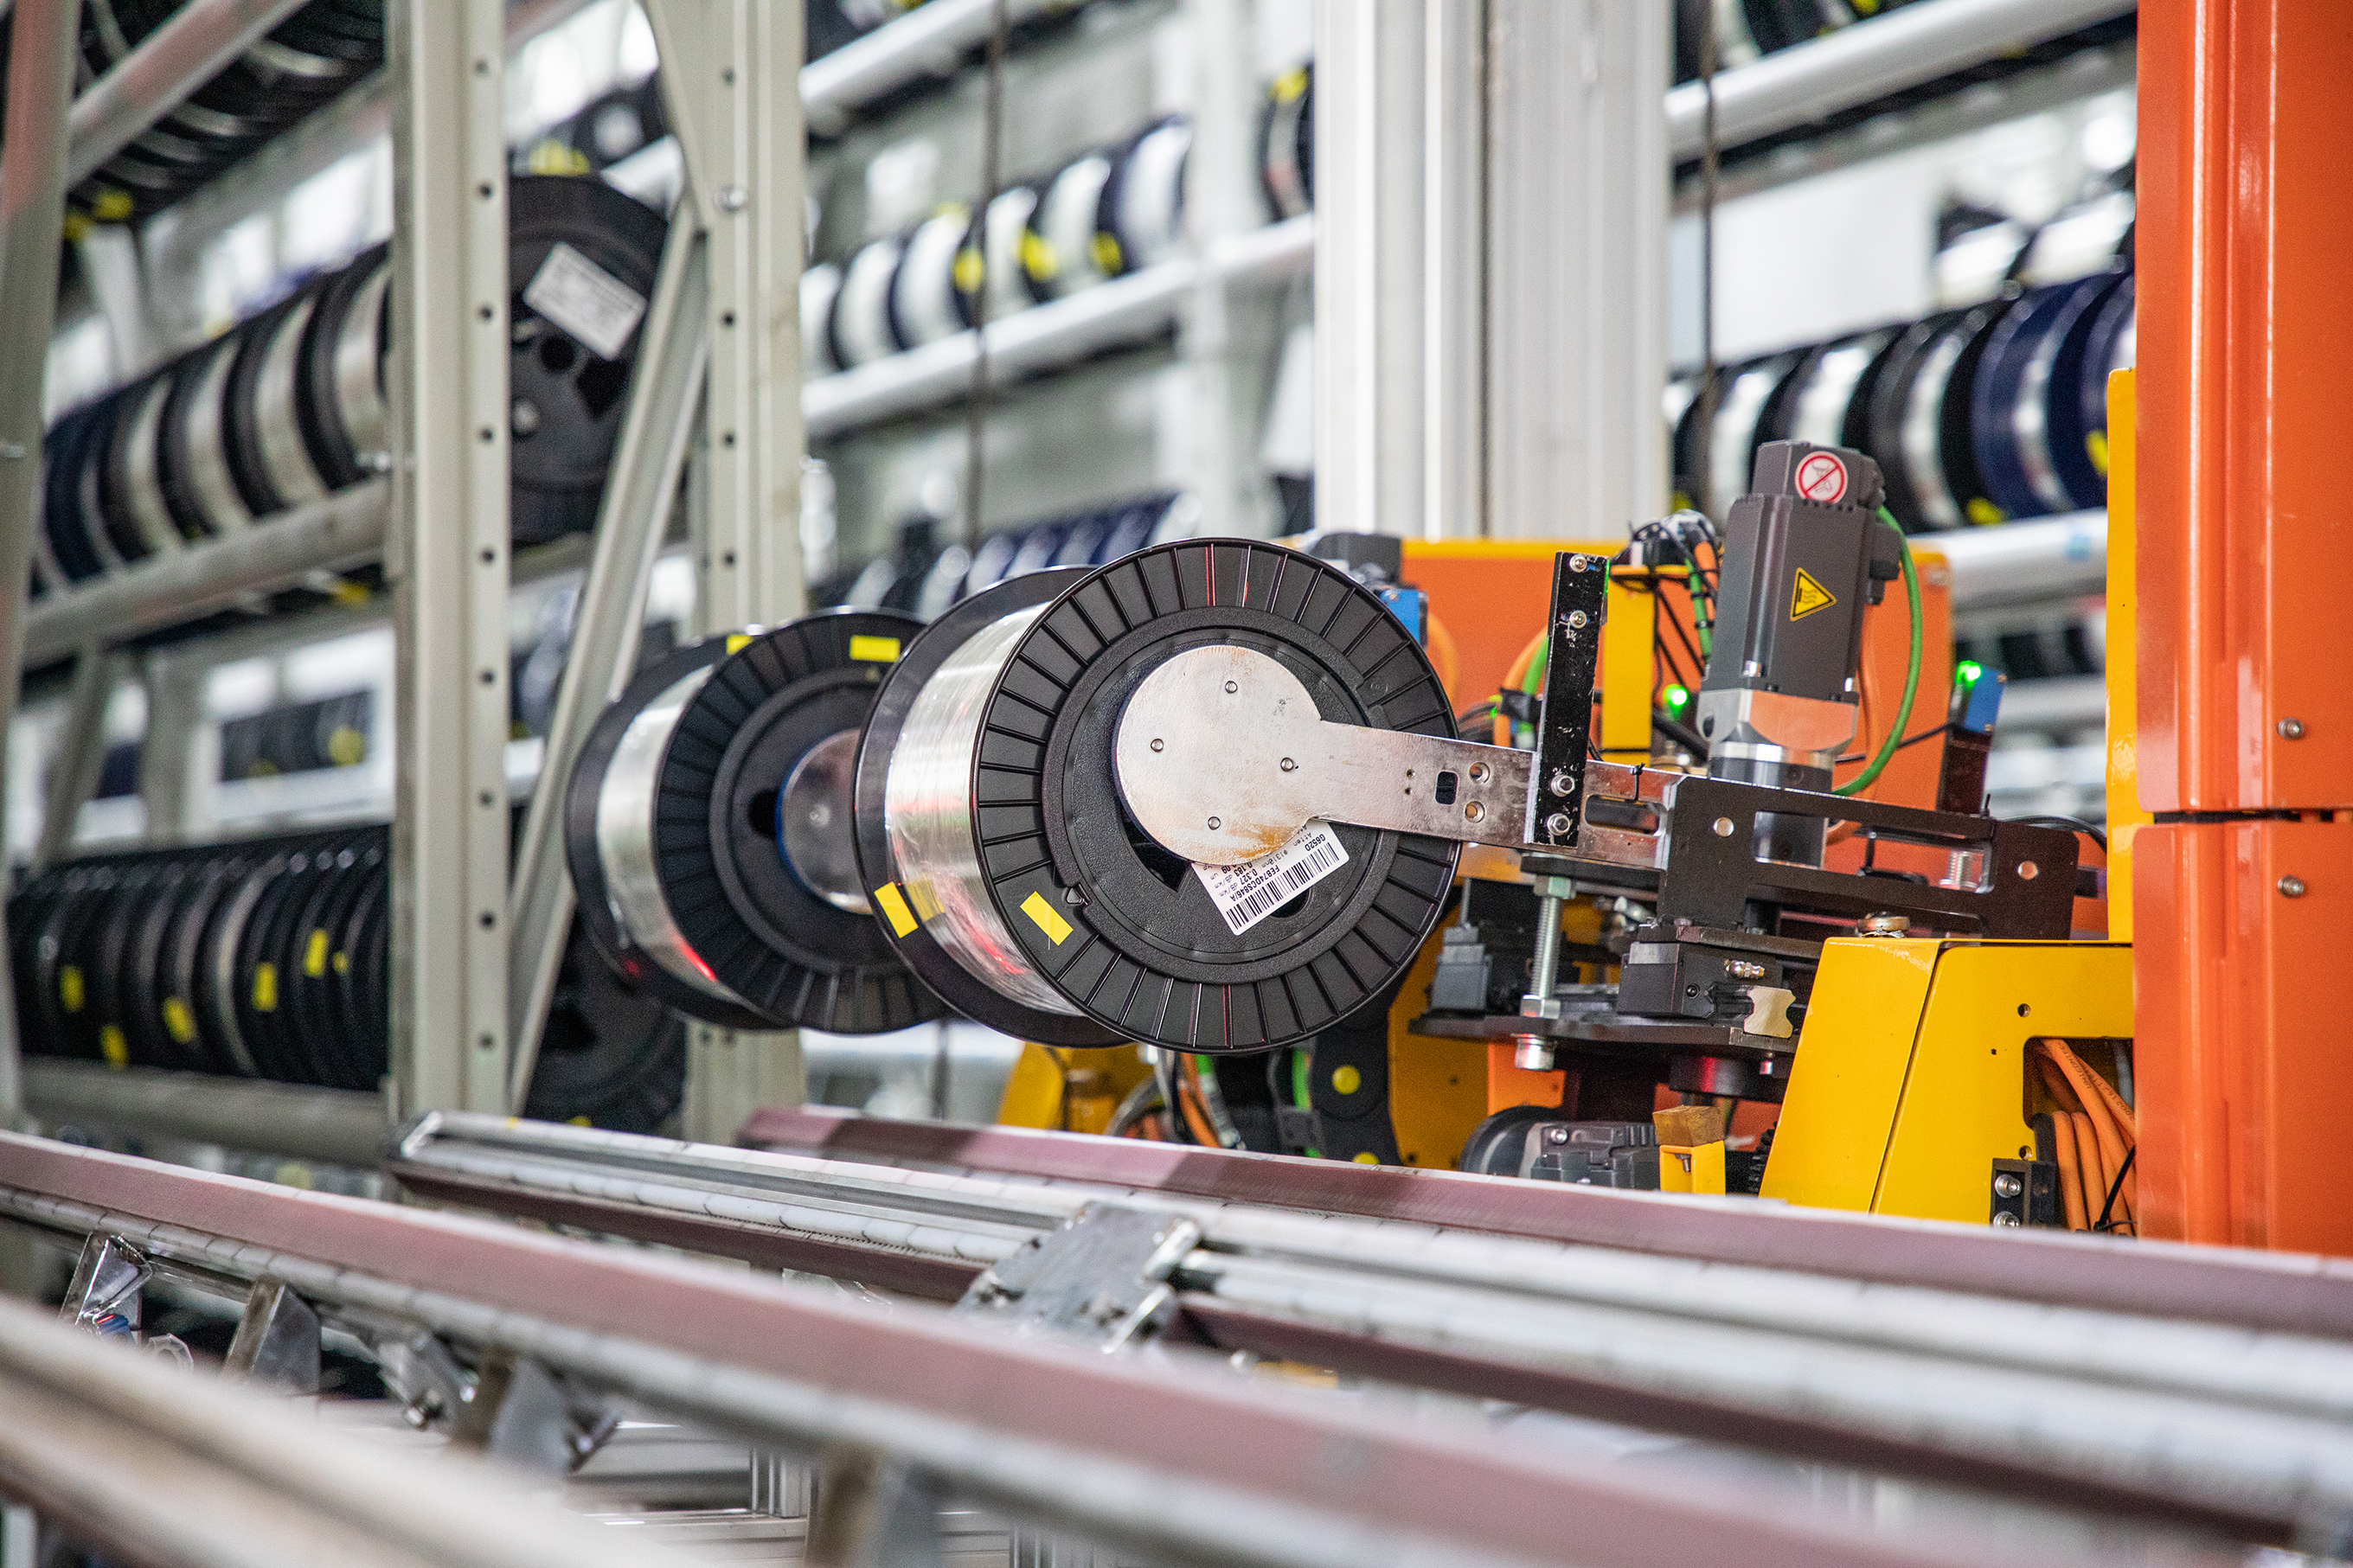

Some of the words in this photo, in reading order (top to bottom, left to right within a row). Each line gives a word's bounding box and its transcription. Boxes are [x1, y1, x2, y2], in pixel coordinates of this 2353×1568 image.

[1303, 833, 1326, 852] G652D
[1233, 861, 1253, 877] 0.183
[1237, 867, 1258, 885] 0.327
[1213, 873, 1234, 889] dB/km
[1218, 881, 1239, 898] dB/km
